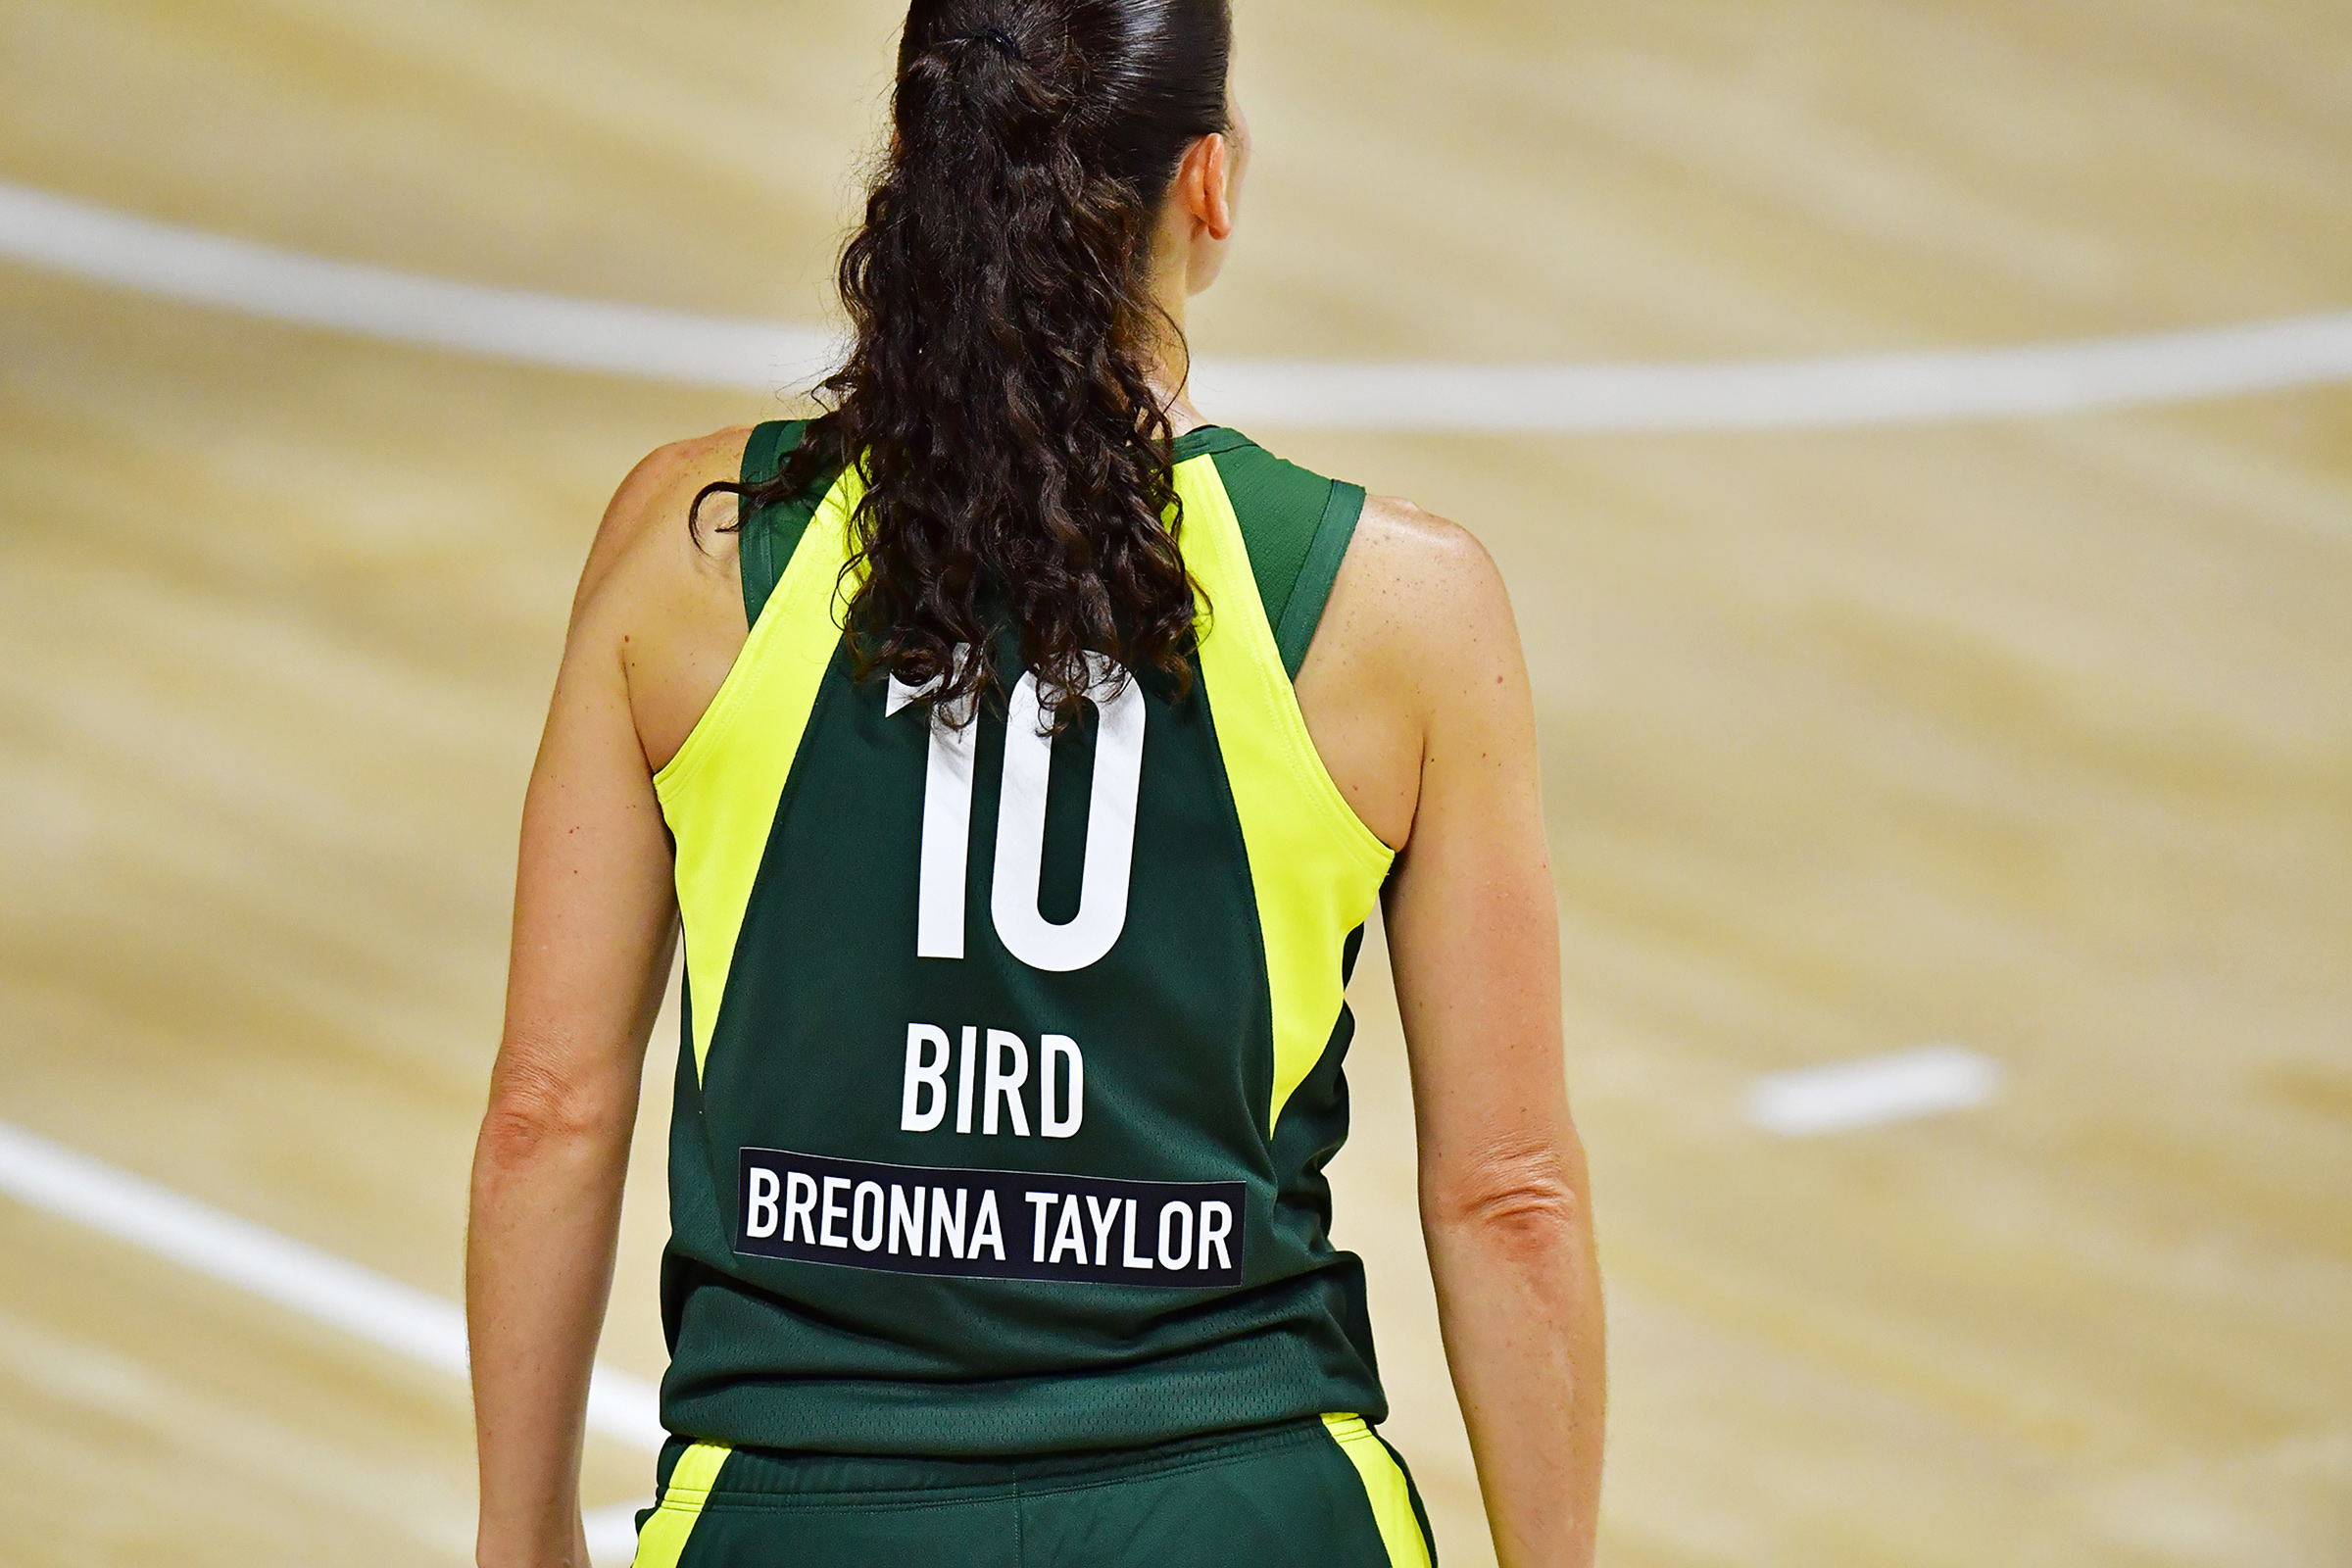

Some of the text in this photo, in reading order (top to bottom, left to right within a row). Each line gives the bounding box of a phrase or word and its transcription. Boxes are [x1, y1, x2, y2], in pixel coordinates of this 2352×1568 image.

[885, 642, 1147, 972] 10
[900, 1022, 1084, 1139] BIRD
[746, 1166, 1233, 1271] BREONNA TAYLOR
